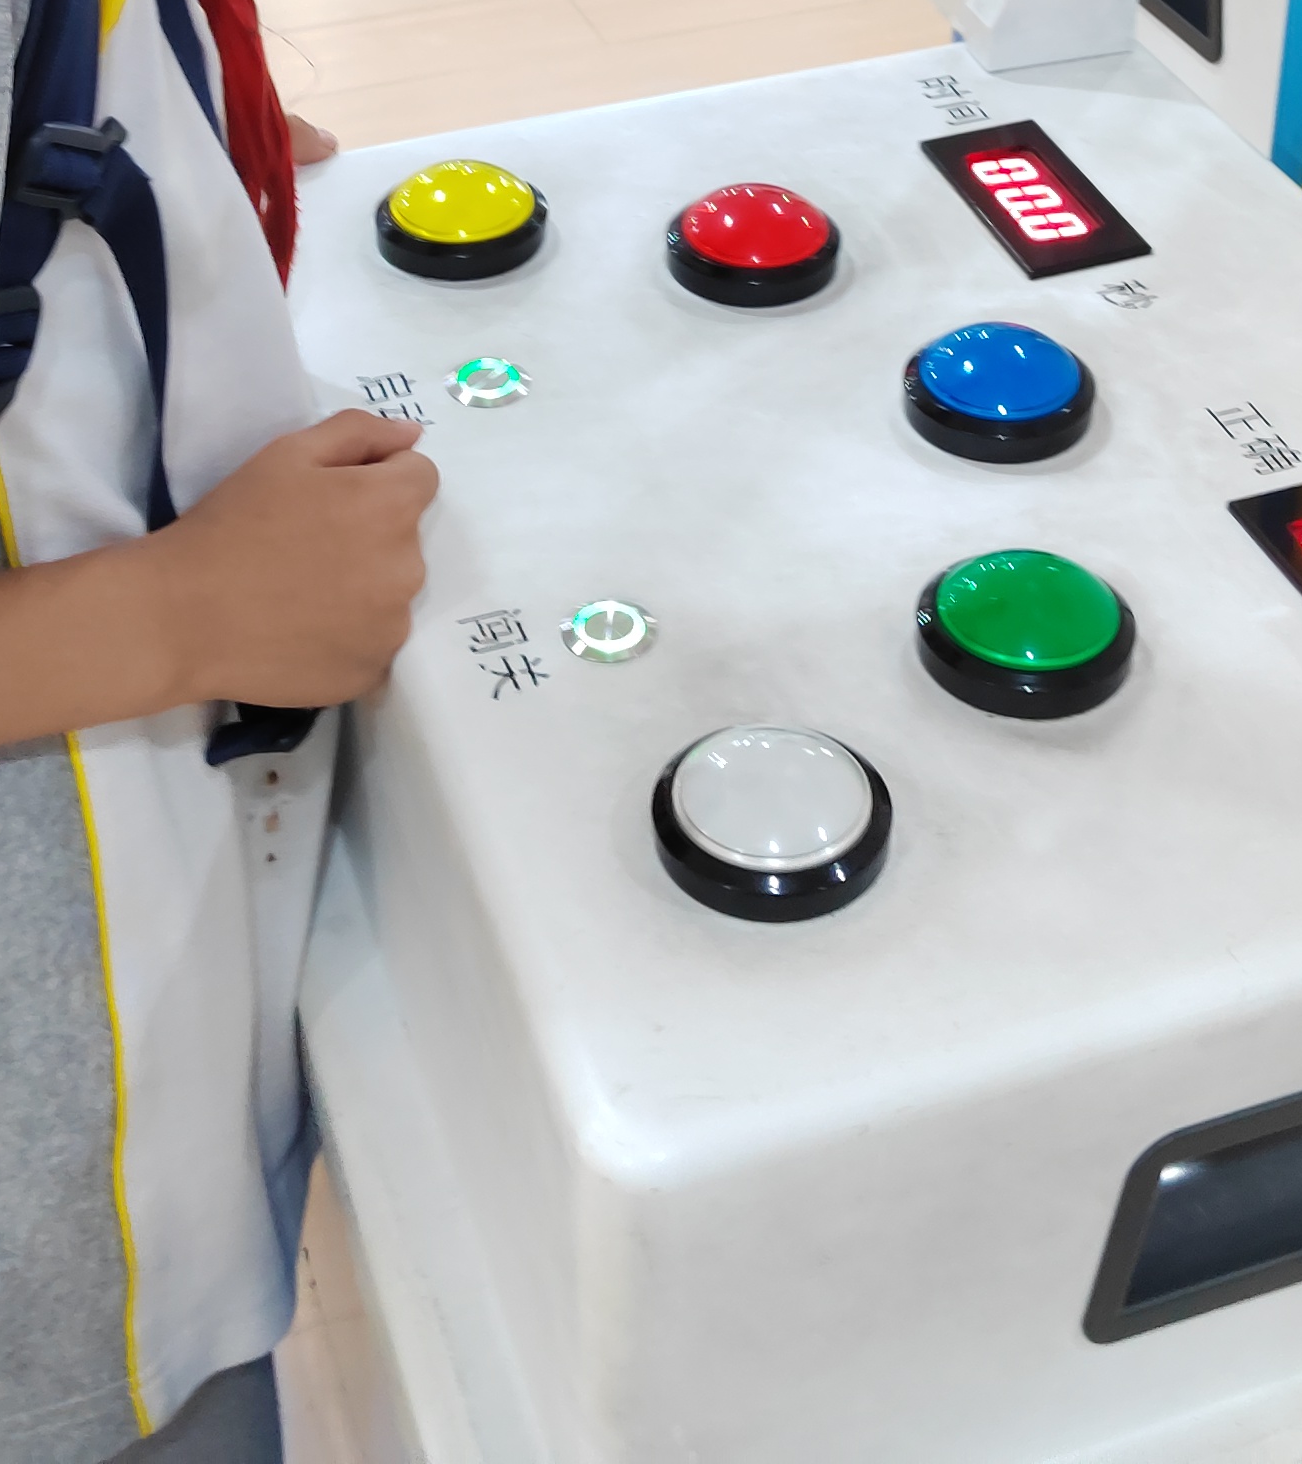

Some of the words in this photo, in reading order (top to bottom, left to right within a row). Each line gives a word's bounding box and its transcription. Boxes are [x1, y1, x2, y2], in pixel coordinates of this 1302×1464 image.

[915, 73, 991, 126] 时间
[1095, 279, 1159, 310] 秒
[1205, 400, 1302, 476] 正确
[456, 608, 551, 701] 闯关
